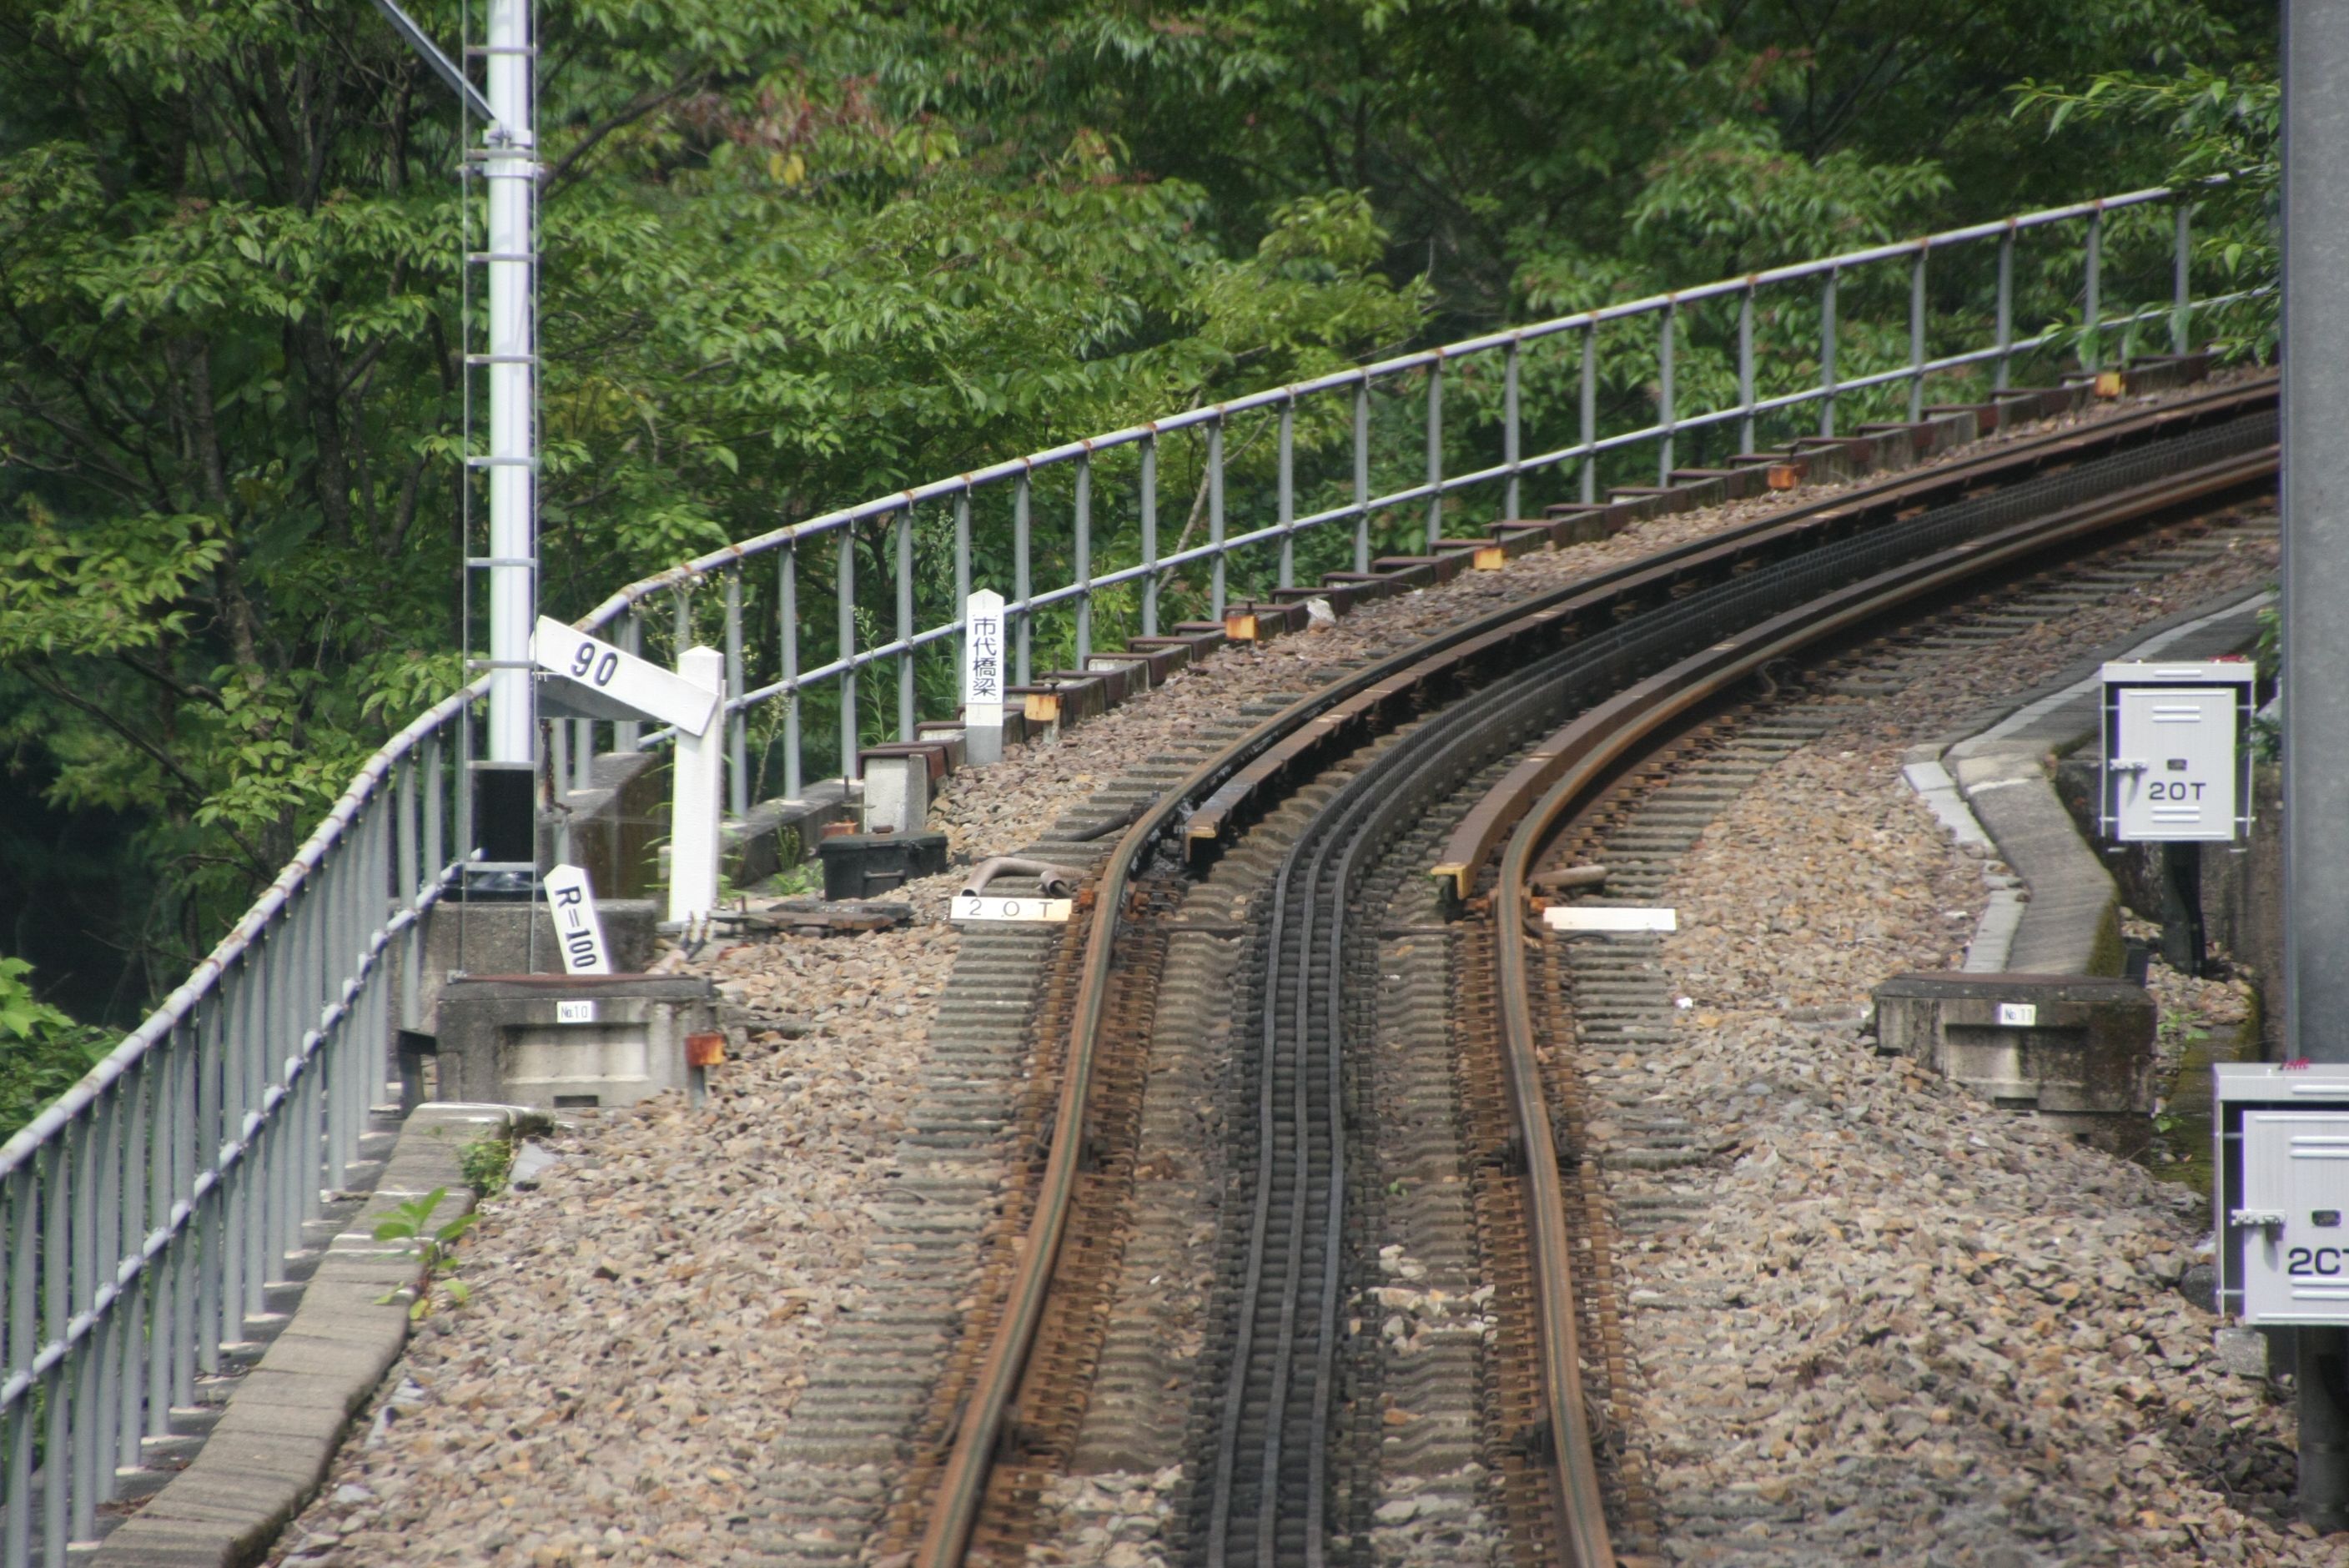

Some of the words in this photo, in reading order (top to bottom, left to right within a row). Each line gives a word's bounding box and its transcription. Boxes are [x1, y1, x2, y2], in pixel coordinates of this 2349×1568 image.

[571, 641, 618, 686] 90
[973, 617, 997, 696] 市代橋梁
[555, 886, 597, 967] R=100
